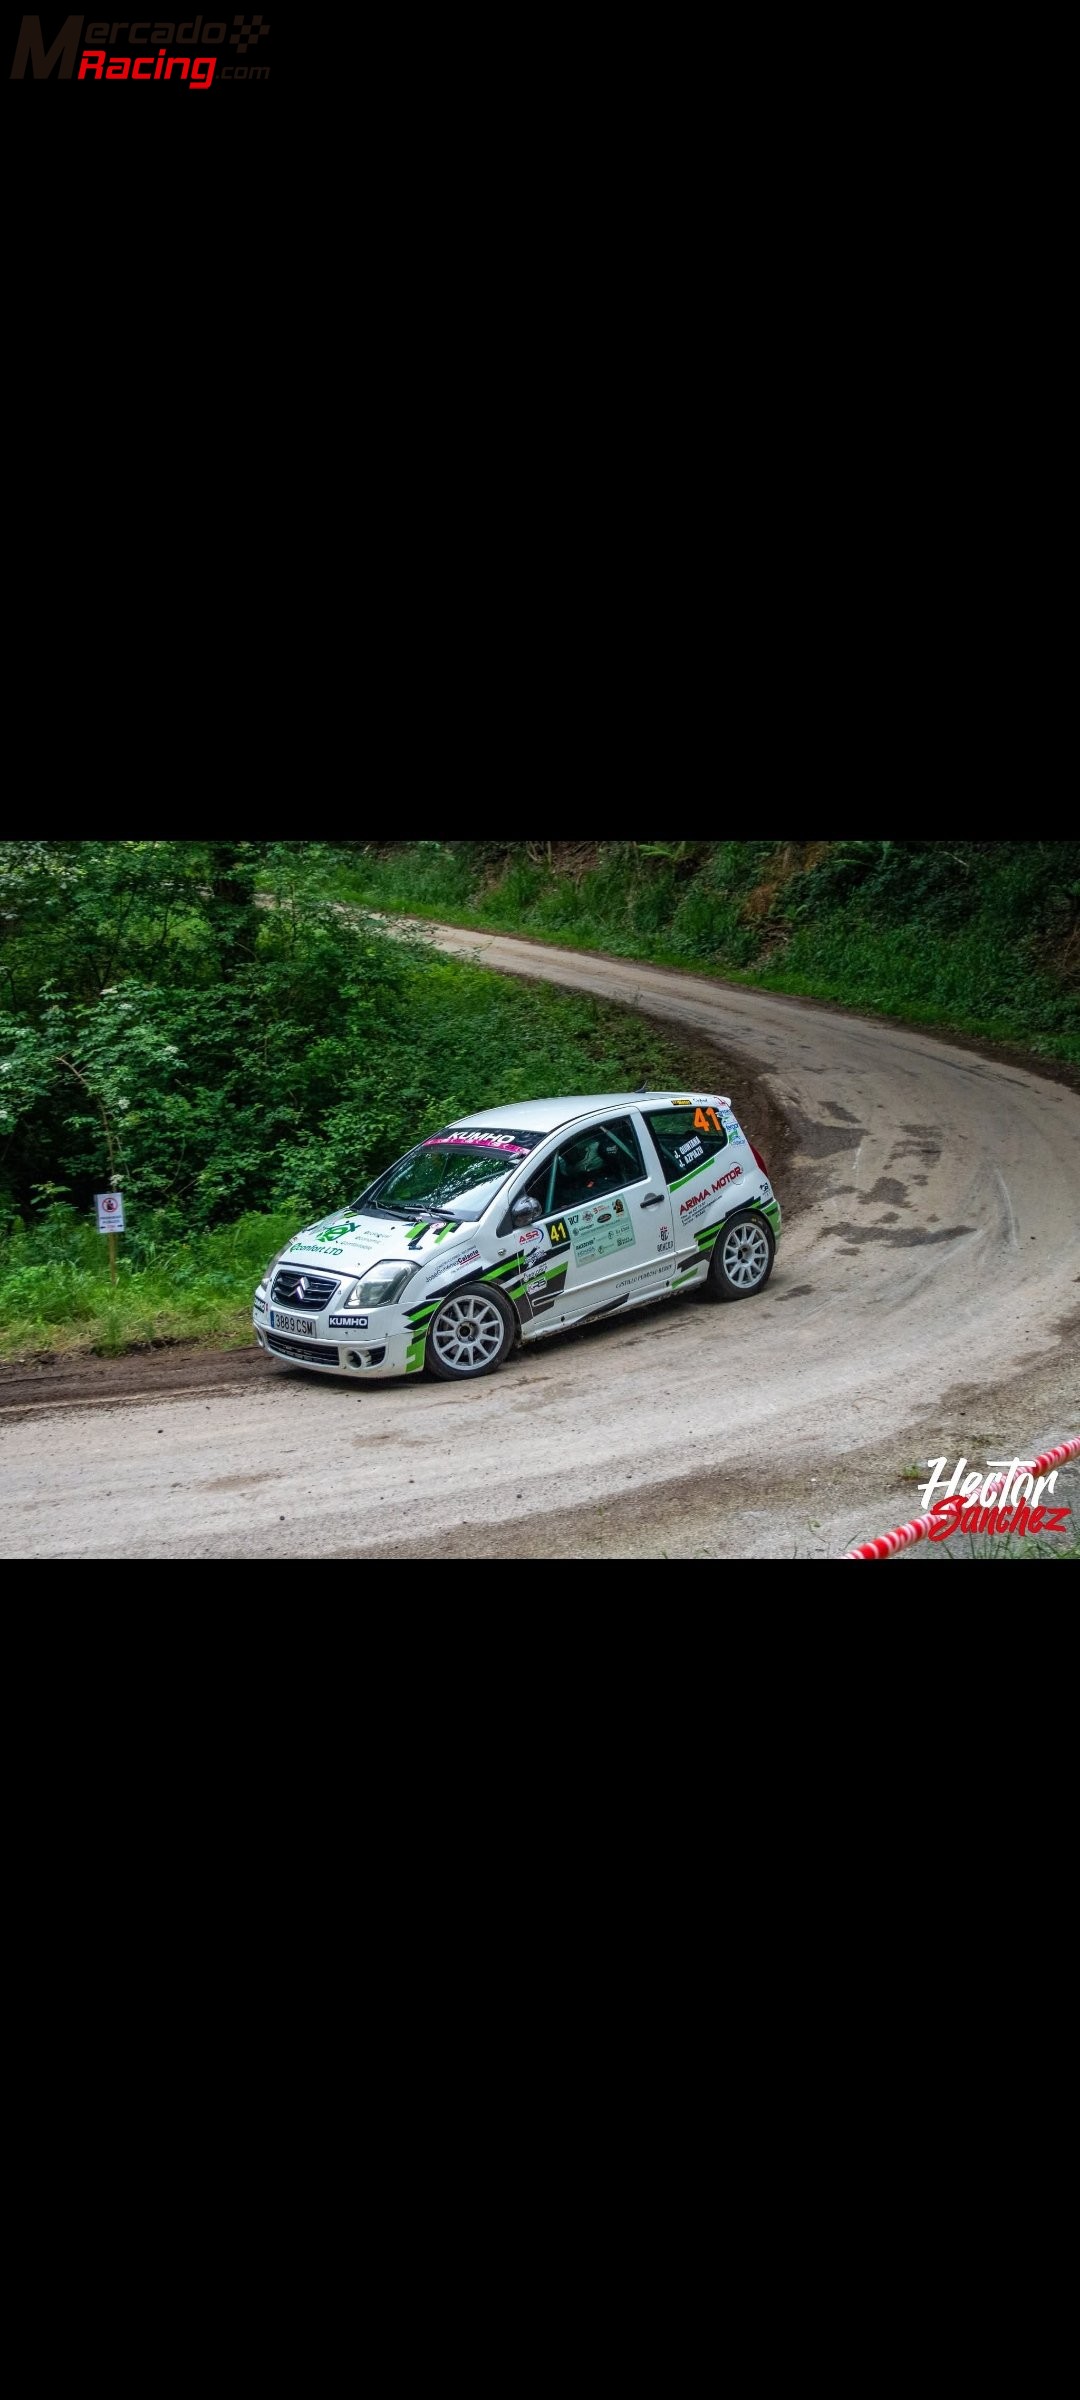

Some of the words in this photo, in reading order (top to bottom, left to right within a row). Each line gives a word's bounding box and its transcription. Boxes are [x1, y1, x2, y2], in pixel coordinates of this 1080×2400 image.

[694, 1107, 721, 1131] 41
[447, 1132, 516, 1144] KUMHO
[680, 1189, 711, 1215] ARIMA
[711, 1166, 743, 1193] MOTOR
[519, 1230, 539, 1243] ASR
[551, 1222, 567, 1241] 41
[324, 1247, 343, 1255] LTD
[296, 1317, 313, 1336] CSM
[329, 1317, 368, 1327] KUMHO
